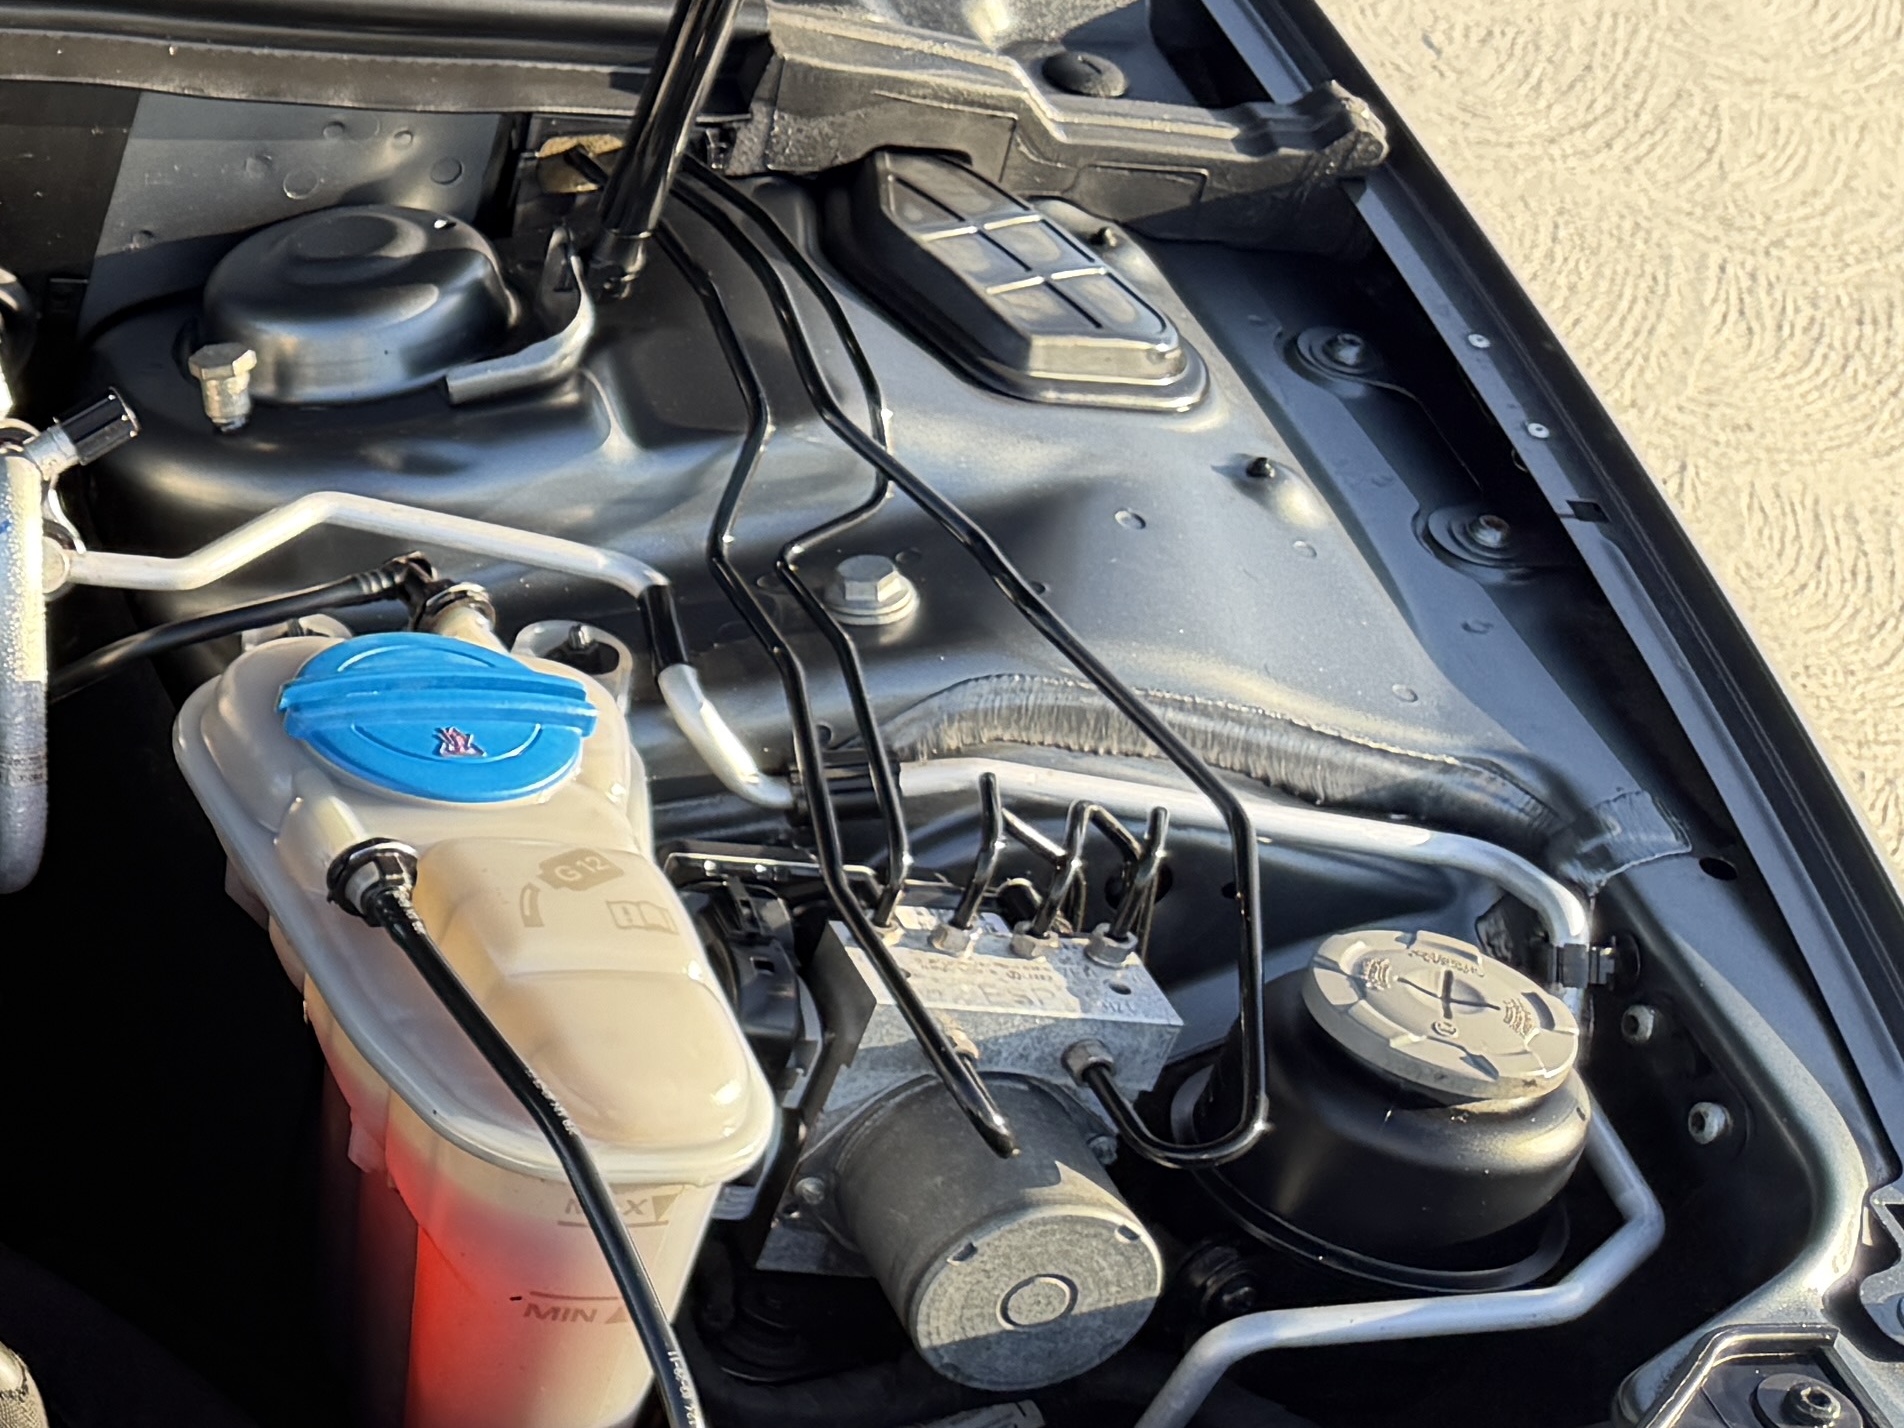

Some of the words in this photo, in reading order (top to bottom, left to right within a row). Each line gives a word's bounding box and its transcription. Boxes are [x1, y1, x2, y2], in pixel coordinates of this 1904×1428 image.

[554, 865, 582, 882] G
[576, 855, 611, 873] 12
[564, 1198, 649, 1215] MX
[522, 1303, 598, 1323] MIN
